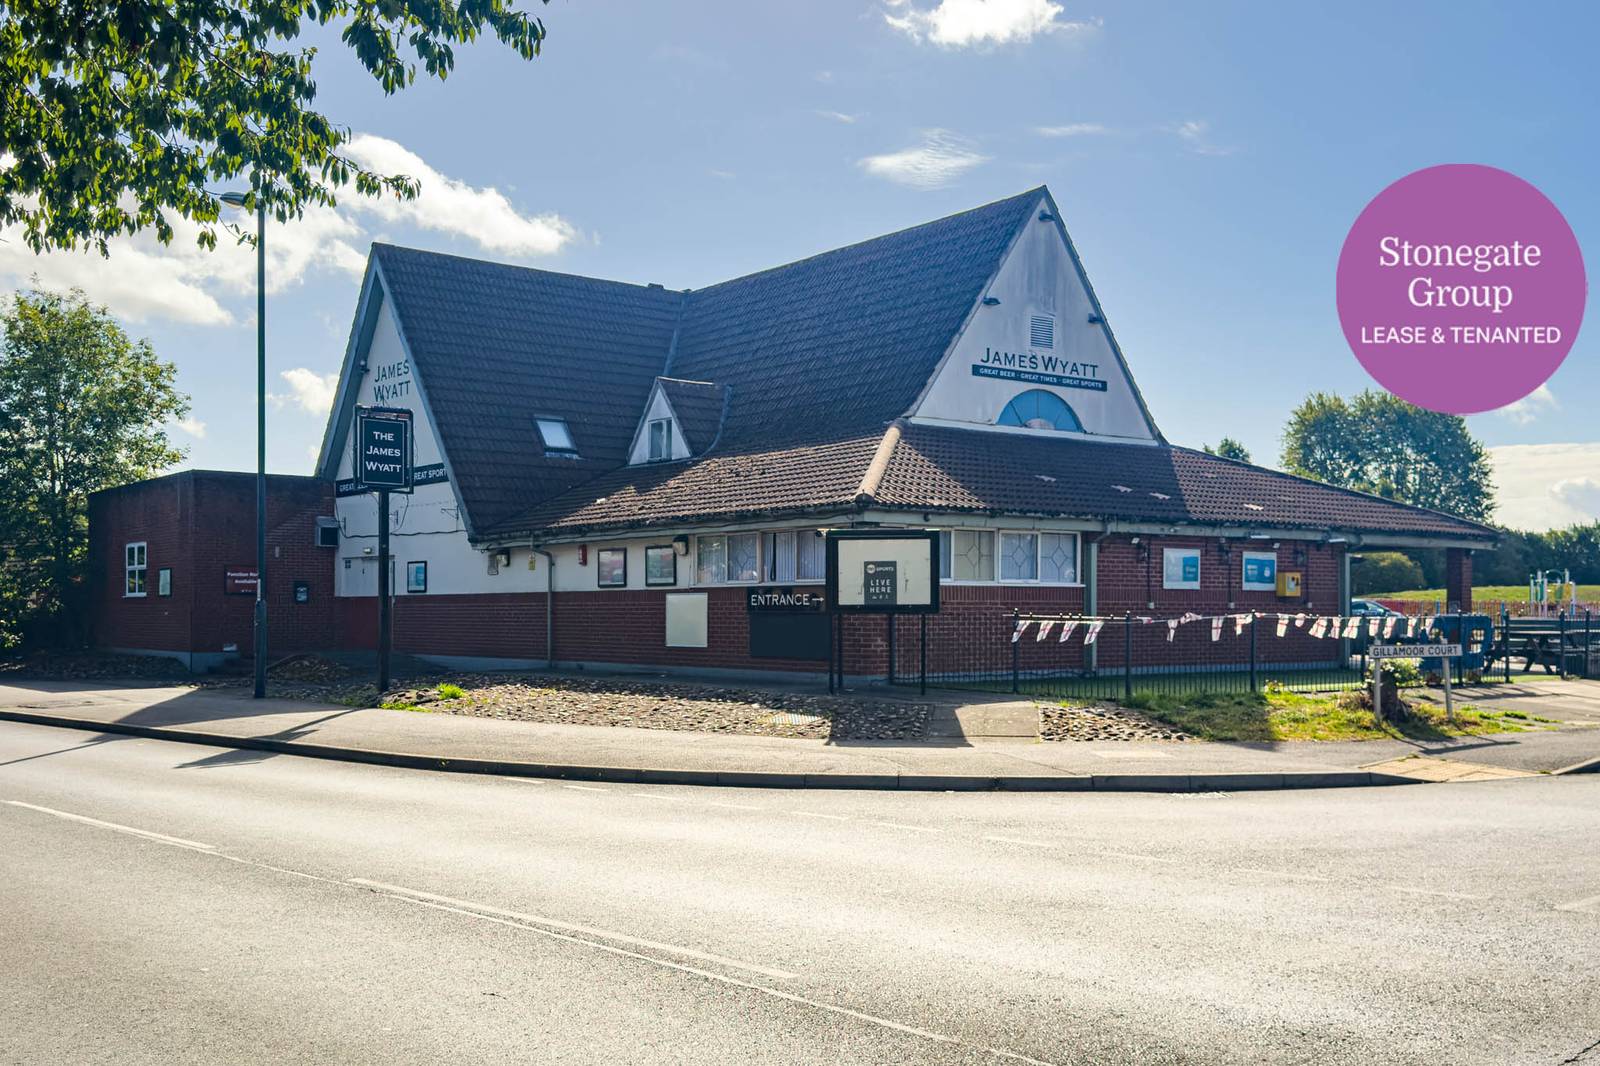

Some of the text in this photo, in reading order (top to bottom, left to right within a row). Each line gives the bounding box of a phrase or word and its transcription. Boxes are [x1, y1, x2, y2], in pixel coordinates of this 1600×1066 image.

[980, 347, 1099, 378] JAMES WYATT
[375, 360, 410, 382] JAMES
[979, 367, 998, 376] GREAT
[999, 369, 1016, 378] BEER
[1020, 373, 1039, 381] GREAT
[1040, 375, 1057, 383] TIMES
[1080, 380, 1102, 388] SPORTS
[373, 380, 411, 402] WYATT
[373, 431, 394, 441] THE
[366, 445, 401, 457] JAMES
[365, 461, 402, 473] WYATT
[413, 468, 447, 481] REAT SPORT
[751, 593, 811, 606] ENTRANCE
[1373, 646, 1457, 656] GILLAMOOR COURT
